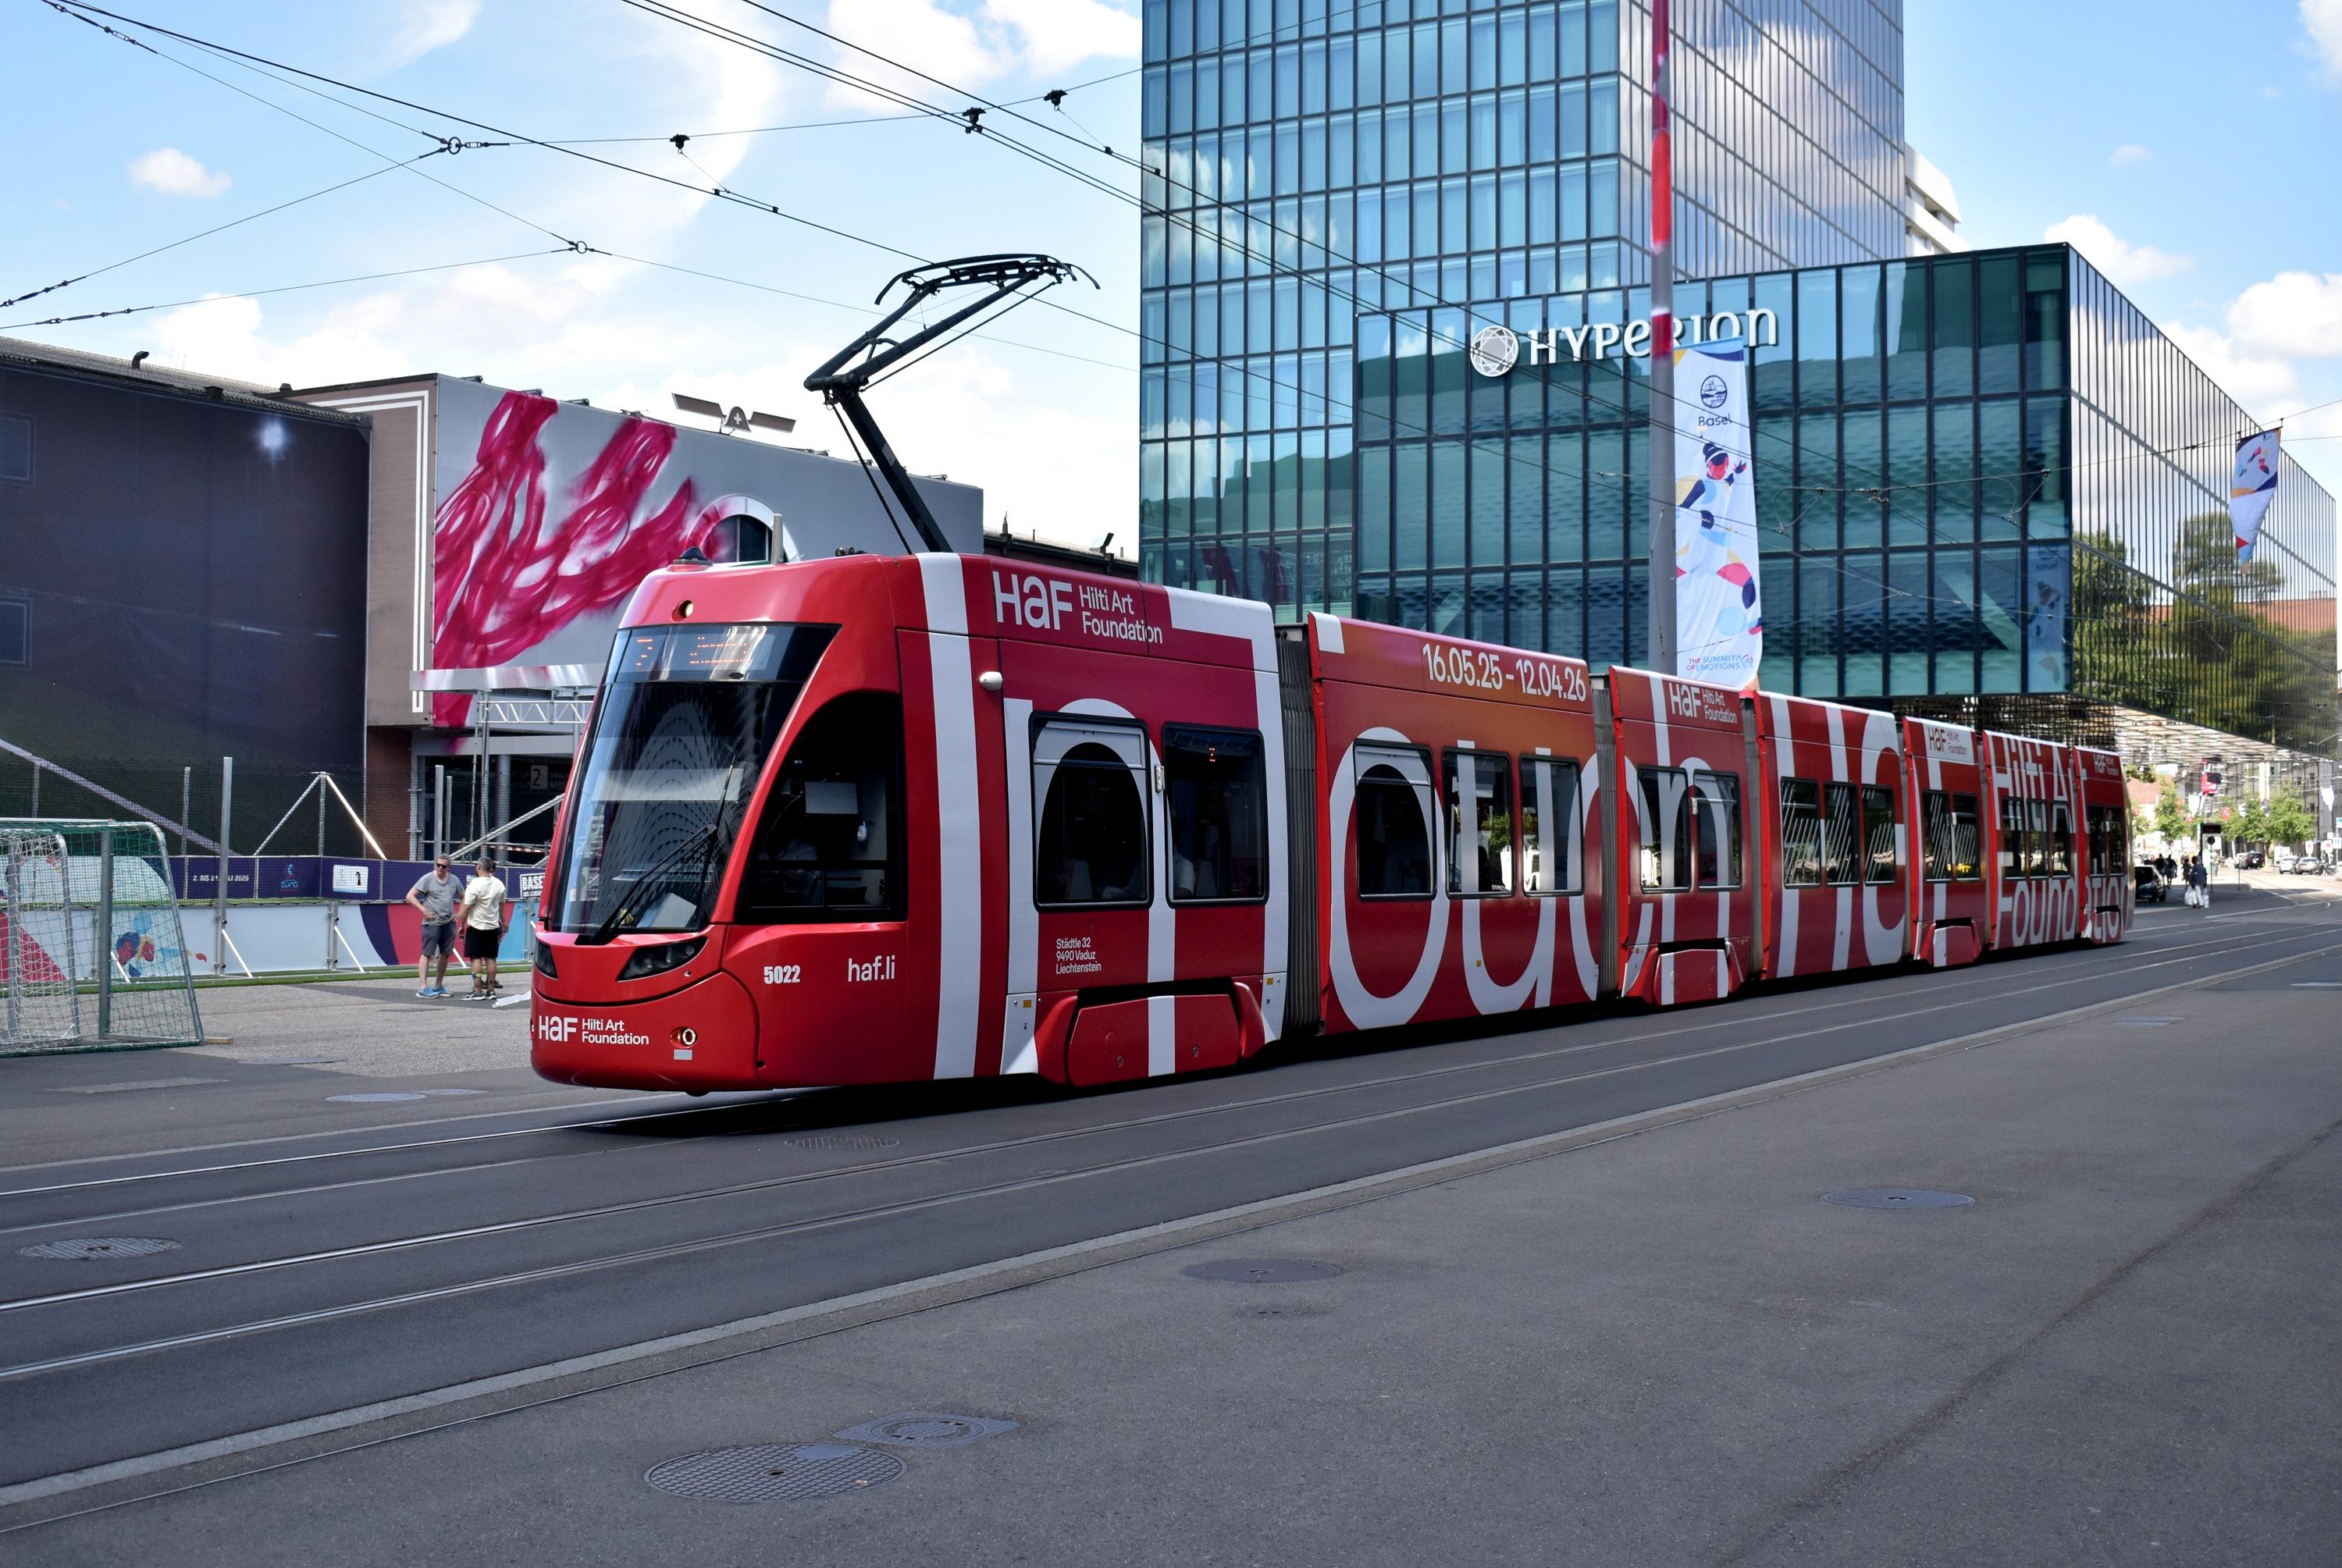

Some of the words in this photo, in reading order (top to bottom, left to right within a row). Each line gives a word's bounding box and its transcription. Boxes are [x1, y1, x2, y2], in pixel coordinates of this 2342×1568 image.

[1699, 412, 1732, 426] Basel
[992, 571, 1073, 631] HaF
[1079, 585, 1109, 611] Hilti
[1112, 590, 1134, 615] Art
[1082, 611, 1163, 644] Foundation
[1422, 643, 1503, 690] 16.05.25
[1515, 659, 1586, 702] 12.04.26
[1696, 662, 1740, 671] EMOTIONS
[1669, 682, 1701, 717] HaF
[1702, 688, 1714, 704] Hilti
[1715, 691, 1725, 706] Art
[1704, 705, 1737, 724] Foundation
[532, 769, 541, 786] 2
[521, 875, 545, 891] BASE
[1056, 937, 1081, 949] Städtle
[1082, 937, 1091, 948] 32
[1056, 950, 1074, 962] 9490
[1075, 949, 1096, 961] Vaduz
[763, 965, 801, 984] 5022
[848, 955, 895, 982] haf.li
[1055, 961, 1102, 975] Liechtenstein
[539, 1015, 578, 1042] HaF
[582, 1018, 603, 1031] Hilti
[605, 1019, 625, 1031] Art
[582, 1031, 650, 1045] Foundation
